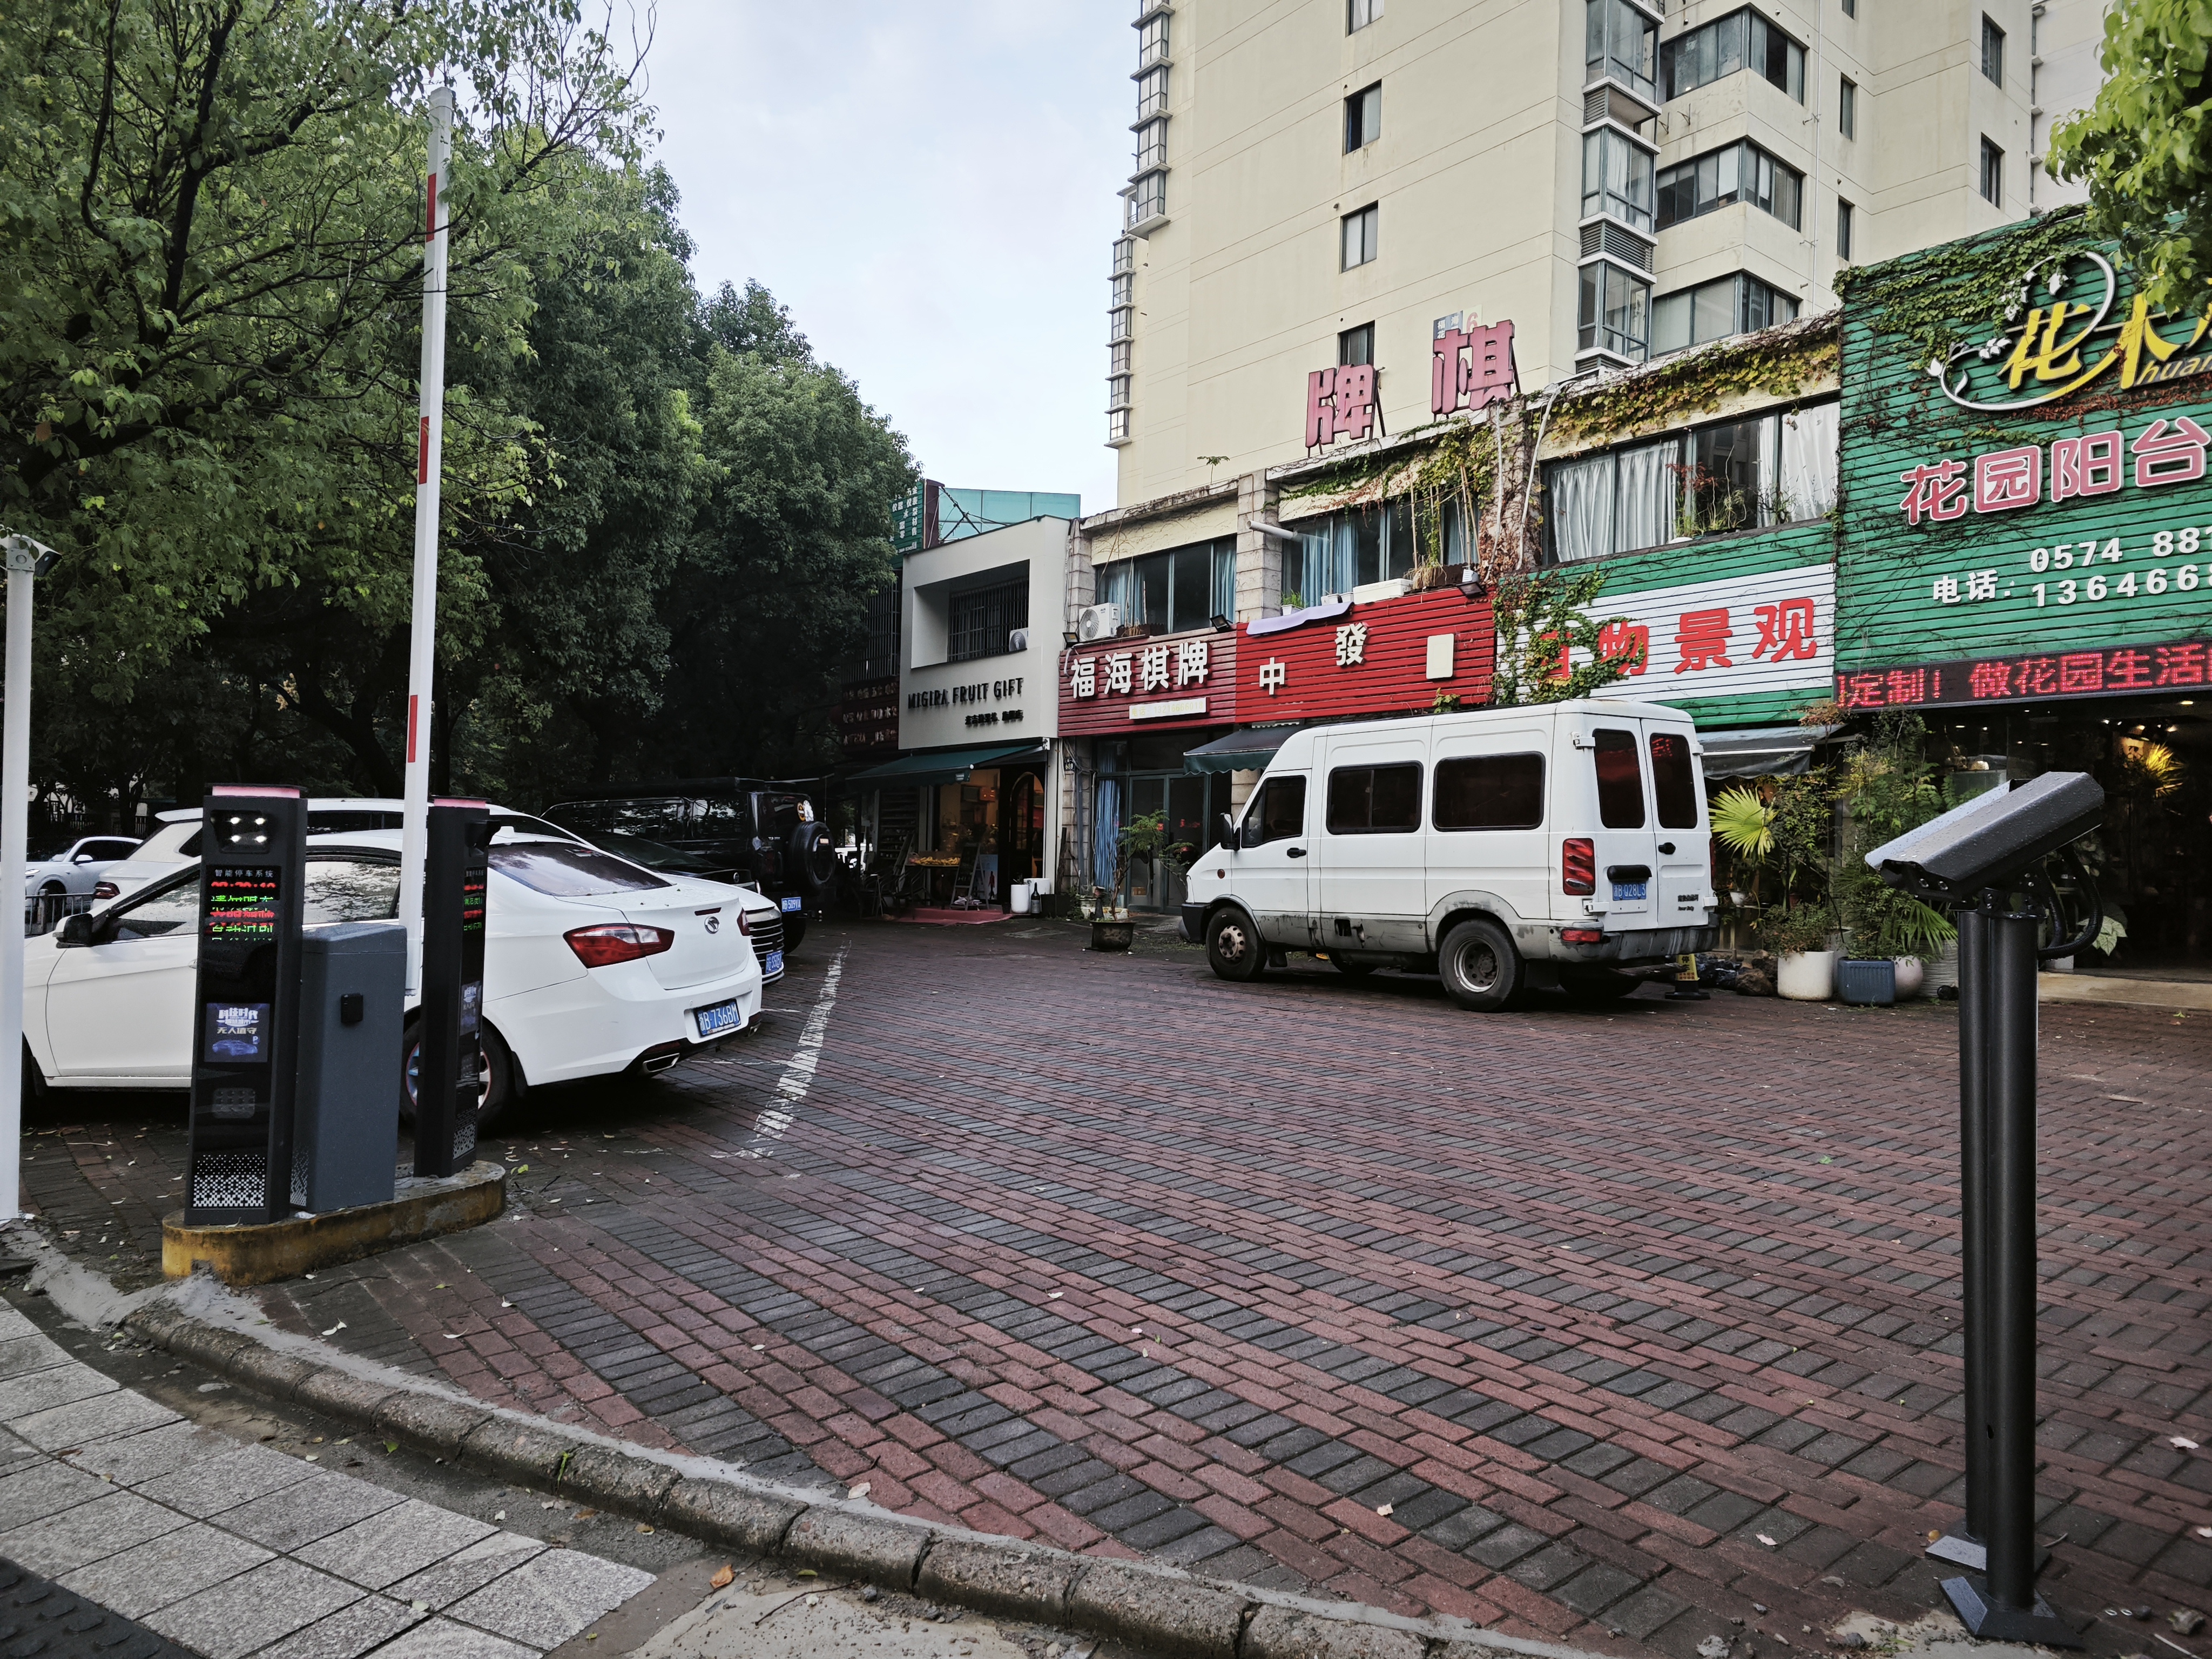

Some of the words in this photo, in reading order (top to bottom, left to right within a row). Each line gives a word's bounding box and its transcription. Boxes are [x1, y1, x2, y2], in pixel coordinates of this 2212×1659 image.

[1998, 292, 2212, 391] 花木
[1899, 416, 2212, 525] 花园阳台
[2030, 538, 2122, 572] 0574
[2032, 564, 2212, 607] 136466
[1070, 640, 1208, 699] 福海棋牌
[1259, 657, 1285, 696] 中
[1838, 669, 1941, 708] 定制!
[1969, 645, 2212, 699] 做花园生活
[908, 689, 948, 709] MIGIRA
[953, 683, 989, 703] FRUIT
[994, 678, 1023, 699] GIFT
[215, 869, 273, 878] 智能停车系统
